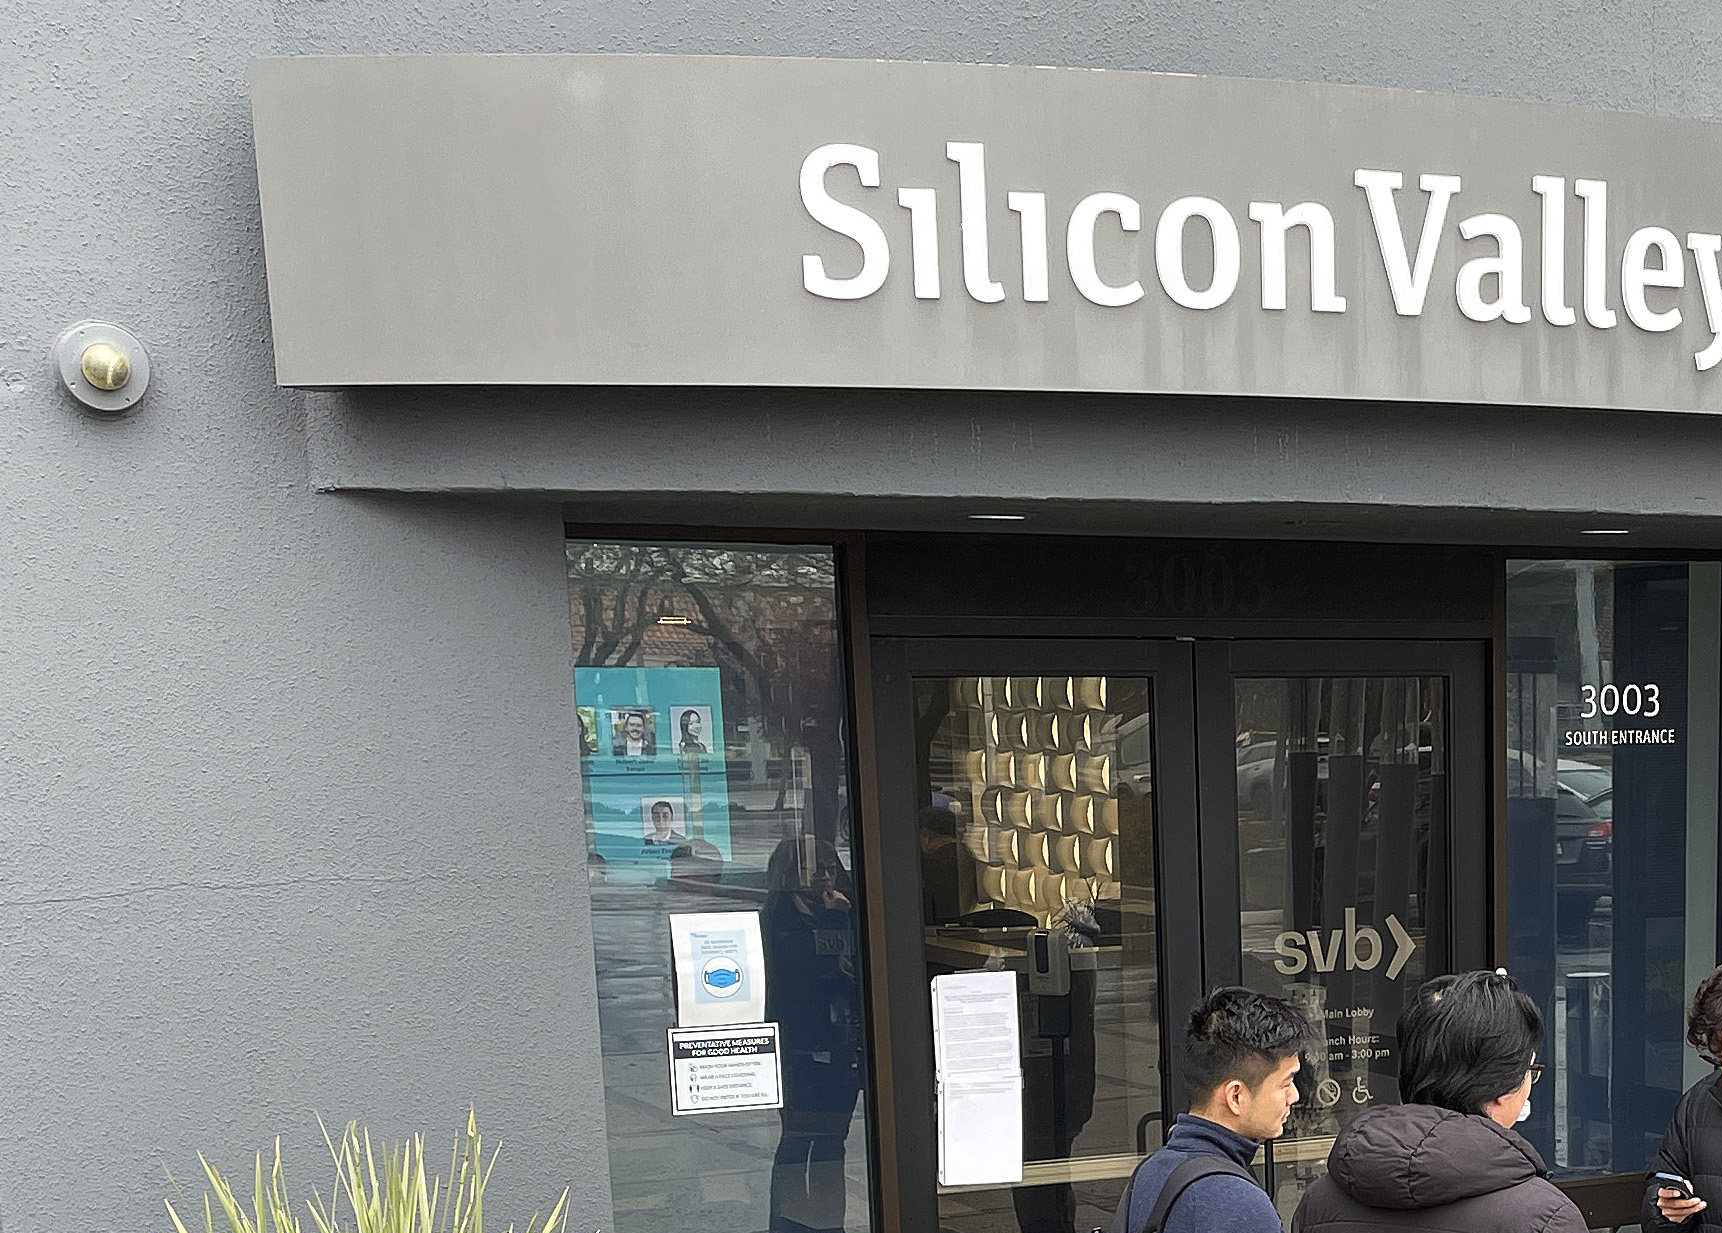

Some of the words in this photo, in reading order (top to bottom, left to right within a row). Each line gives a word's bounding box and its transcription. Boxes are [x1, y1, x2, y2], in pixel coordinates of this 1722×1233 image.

[798, 142, 1347, 312] Silicon
[1580, 683, 1660, 719] 3003
[1565, 730, 1608, 746] SOUTH
[1611, 729, 1676, 744] ENTRANCE
[1273, 906, 1383, 975] svb
[1345, 1006, 1375, 1019] Lobby
[730, 1046, 758, 1055] HEALTH
[1328, 1052, 1344, 1061] am
[1351, 1048, 1373, 1060] 3:00
[1374, 1049, 1390, 1060] pm
